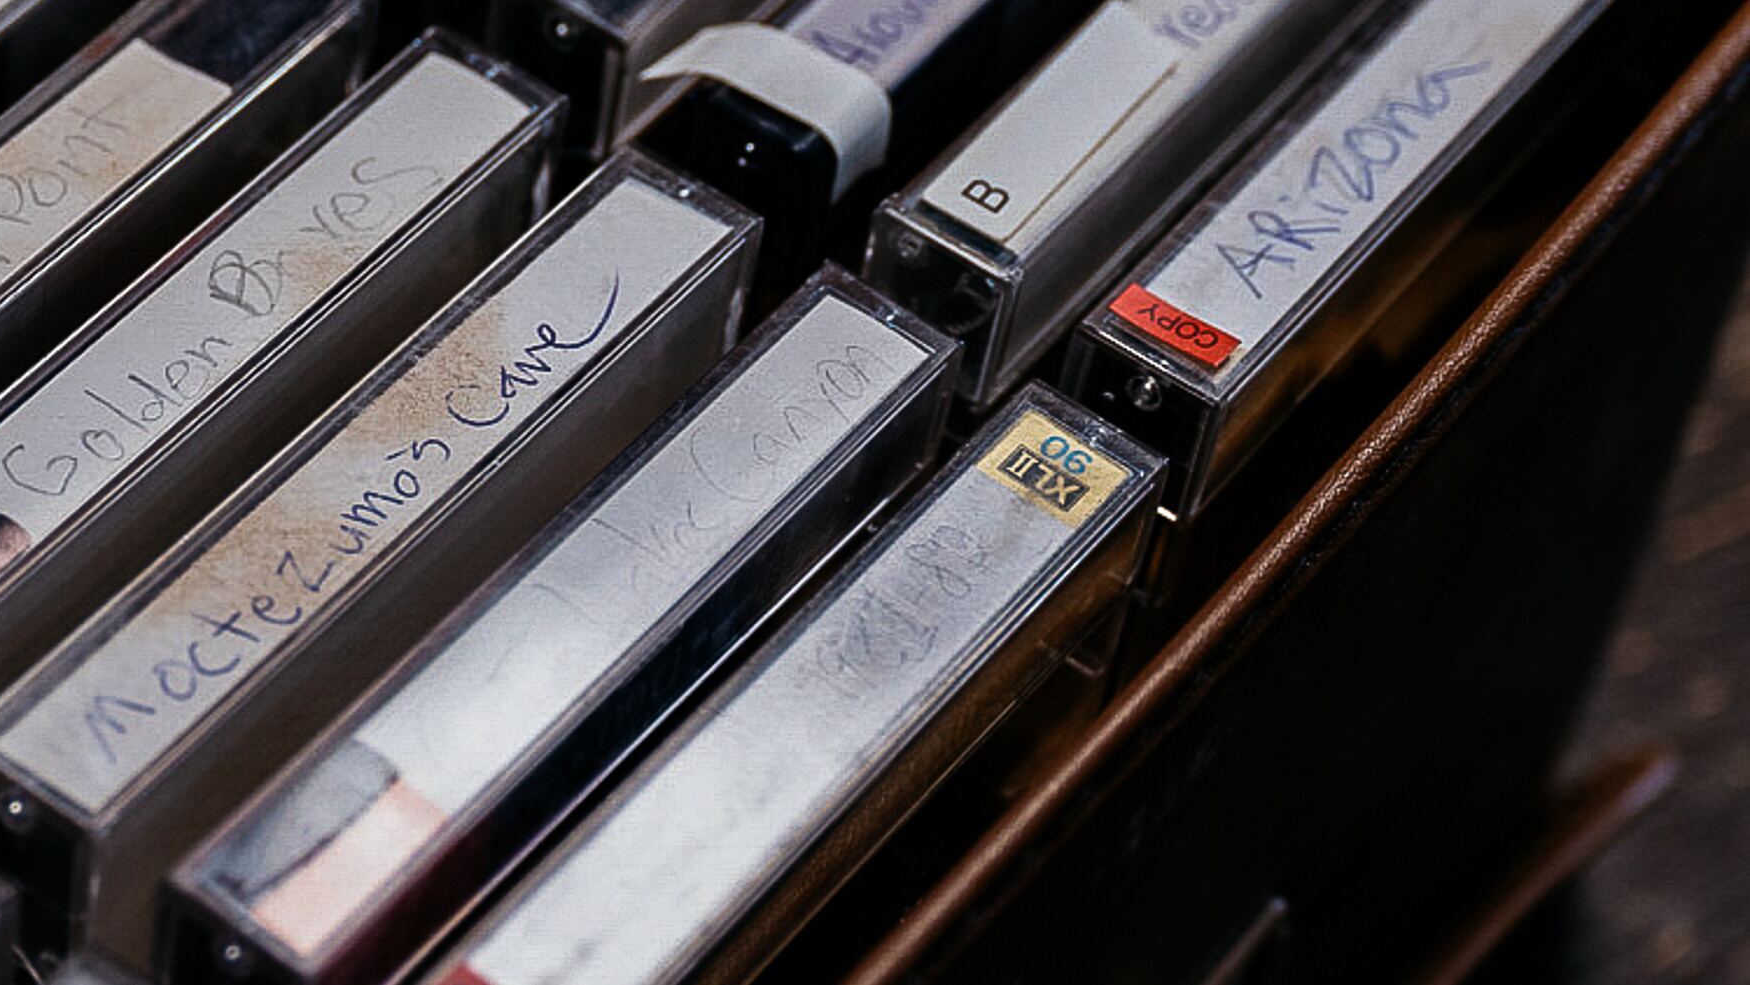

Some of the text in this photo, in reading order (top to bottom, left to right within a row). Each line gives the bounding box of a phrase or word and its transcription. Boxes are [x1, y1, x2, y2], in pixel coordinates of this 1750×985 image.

[961, 177, 1011, 214] B
[446, 266, 620, 428] Cave
[1135, 299, 1222, 351] COPY
[1, 333, 234, 496] Golden
[1038, 434, 1096, 476] 90
